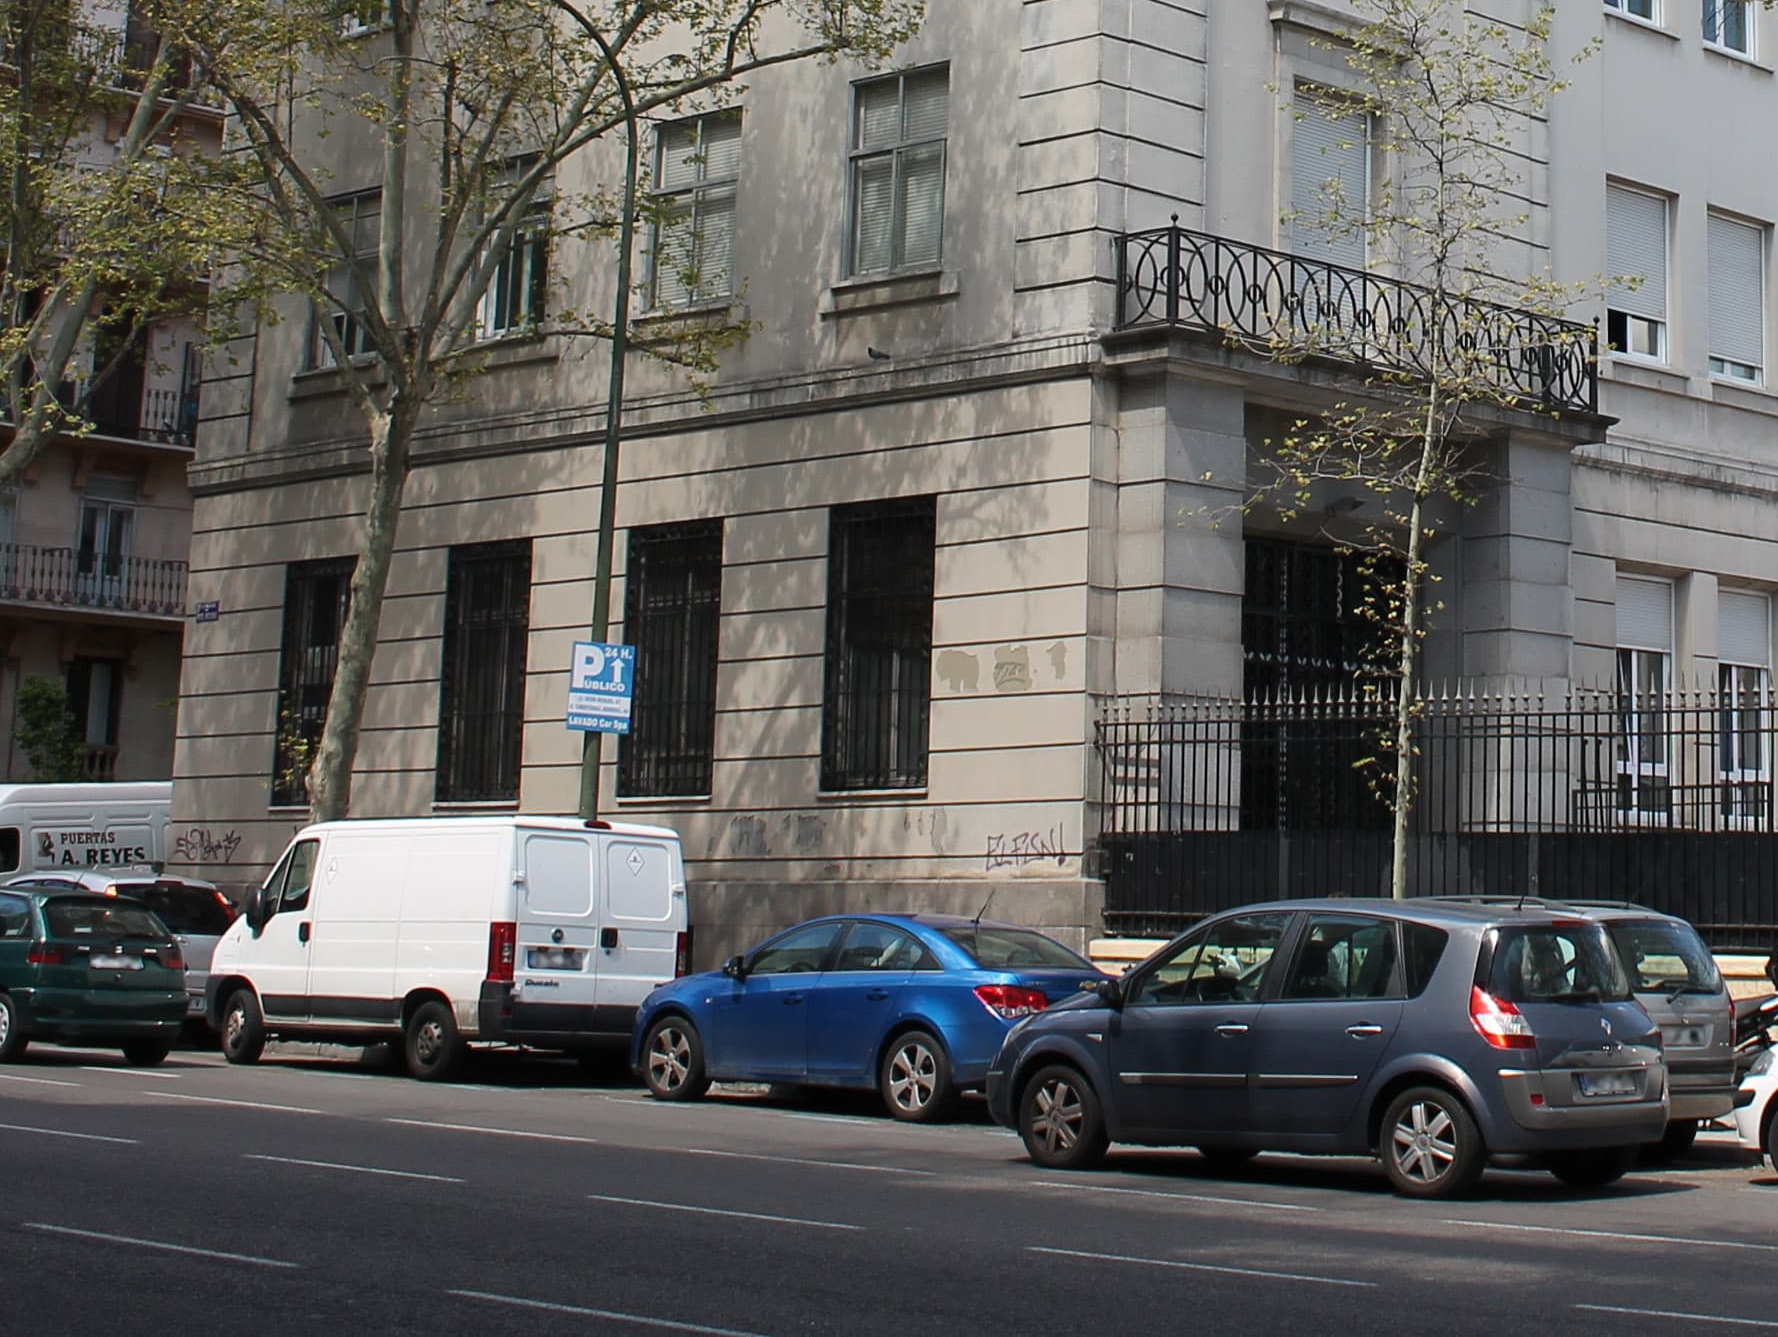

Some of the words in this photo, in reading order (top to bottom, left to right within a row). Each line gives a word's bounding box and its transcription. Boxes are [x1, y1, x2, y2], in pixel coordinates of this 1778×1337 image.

[605, 647, 618, 658] 24
[620, 648, 632, 660] H.
[568, 716, 598, 727] LAVADO
[60, 831, 115, 845] PUERTAS
[61, 849, 80, 865] A.
[86, 847, 146, 864] REYES
